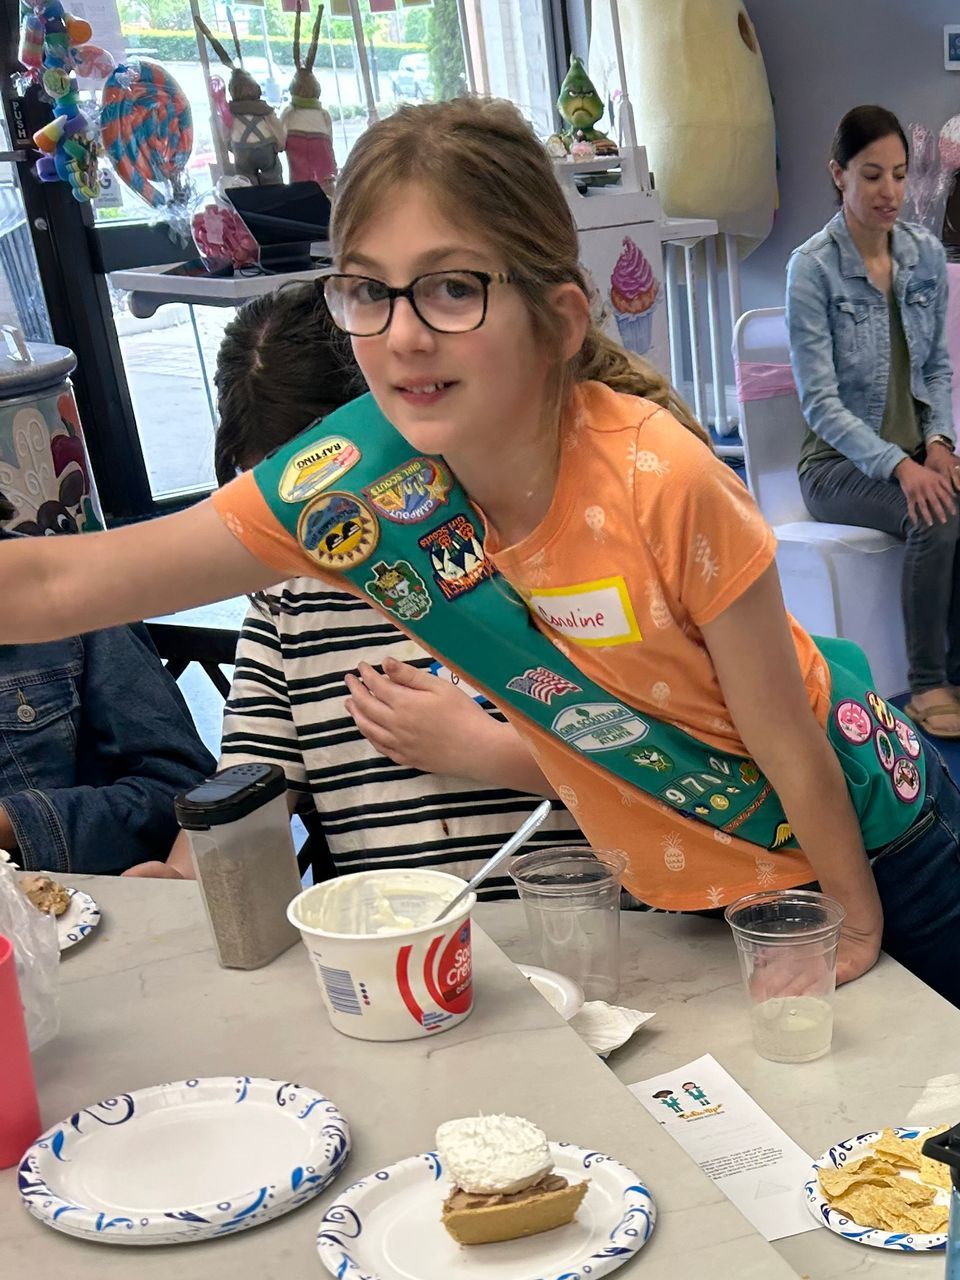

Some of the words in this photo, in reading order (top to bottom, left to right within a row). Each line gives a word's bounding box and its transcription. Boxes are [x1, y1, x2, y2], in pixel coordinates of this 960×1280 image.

[12, 101, 27, 138] PUSH
[296, 442, 342, 469] RAFTING
[402, 461, 421, 477] GIRL
[370, 473, 403, 496] SCOUTS
[448, 516, 465, 531] Girl
[420, 527, 449, 548] Scouts
